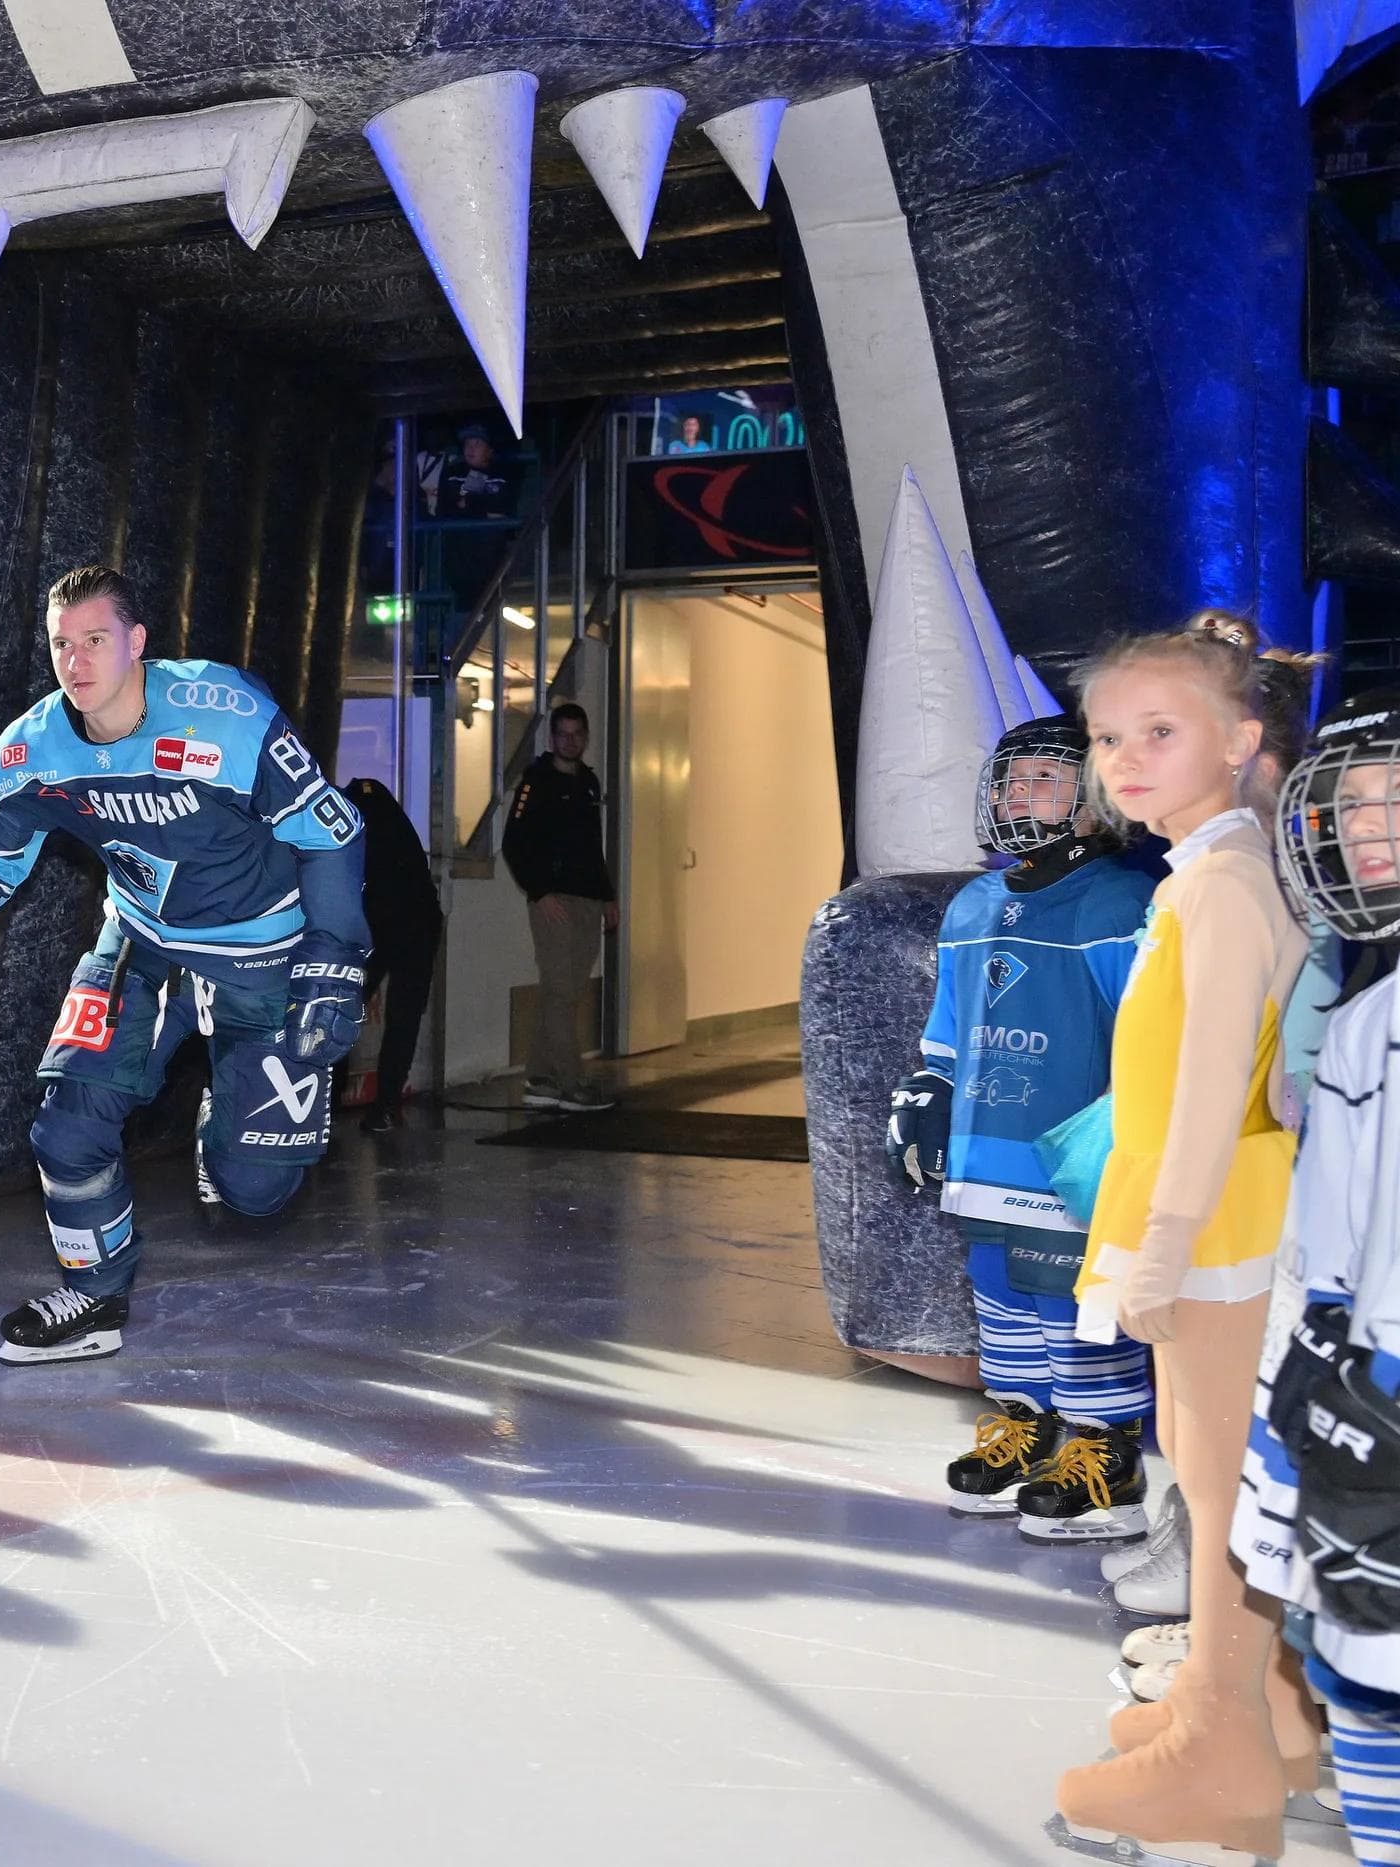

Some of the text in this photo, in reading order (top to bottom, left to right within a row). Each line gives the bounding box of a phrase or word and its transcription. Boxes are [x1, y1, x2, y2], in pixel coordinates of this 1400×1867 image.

[1317, 711, 1390, 738] BAUER
[3, 747, 25, 766] DB
[87, 783, 201, 826] SATURN
[243, 955, 289, 970] BAUER
[239, 1130, 317, 1147] BAUER
[935, 1149, 943, 1170] CCM
[1002, 1196, 1067, 1213] BAUER
